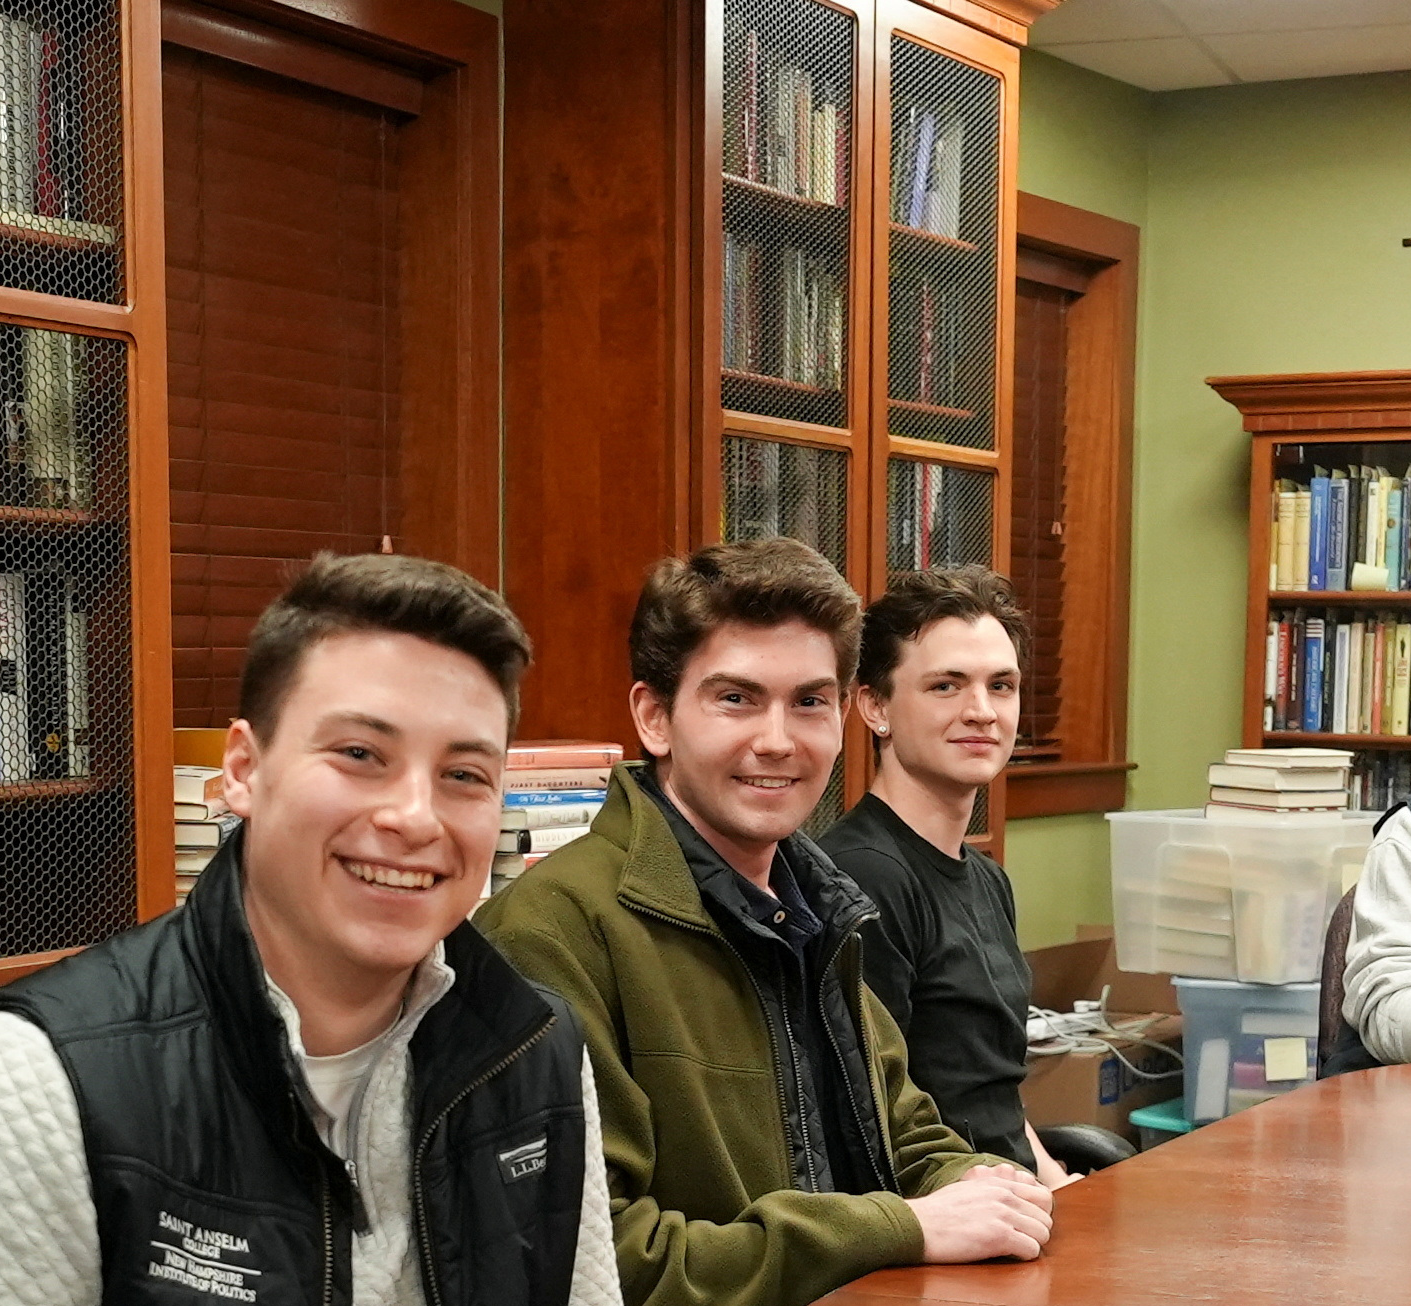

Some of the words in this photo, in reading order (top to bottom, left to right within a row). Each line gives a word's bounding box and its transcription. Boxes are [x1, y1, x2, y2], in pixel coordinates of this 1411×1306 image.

[159, 1211, 194, 1237] SAINT
[195, 1227, 250, 1253] ANSELM
[182, 1237, 221, 1260] COLLEGE
